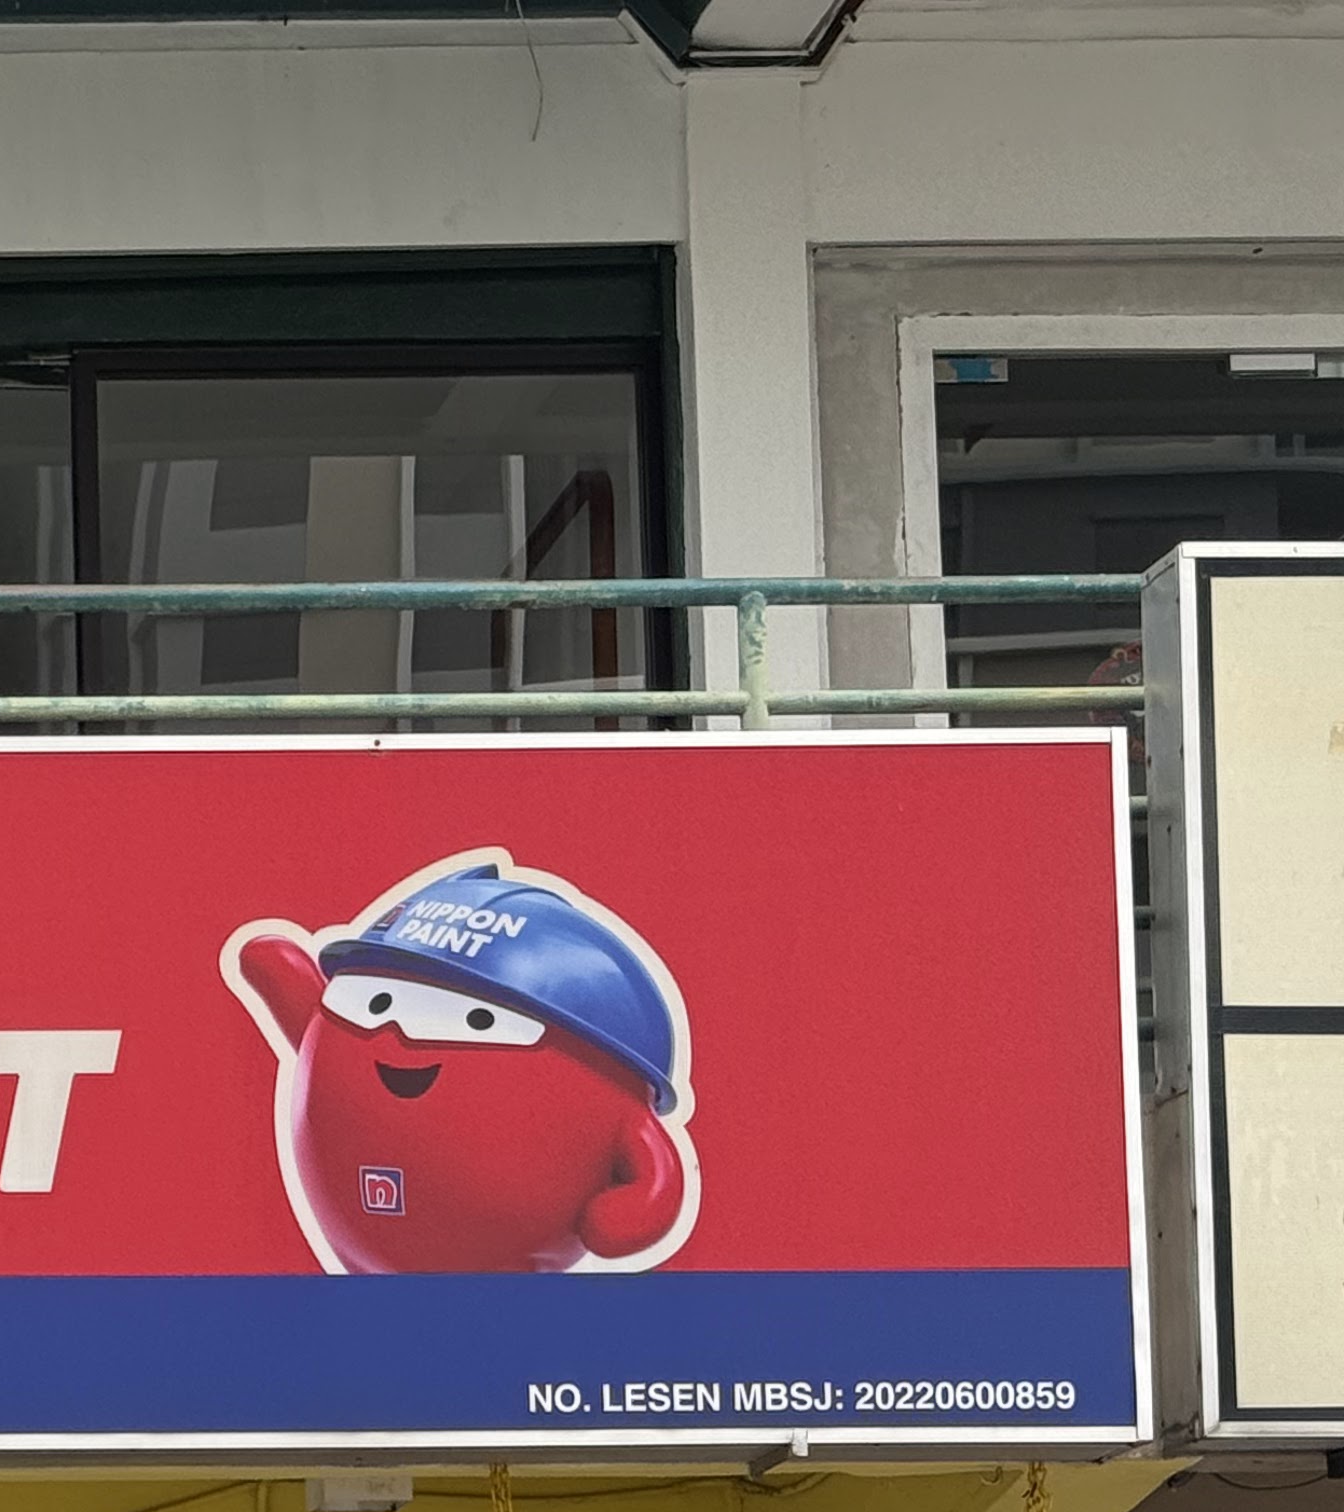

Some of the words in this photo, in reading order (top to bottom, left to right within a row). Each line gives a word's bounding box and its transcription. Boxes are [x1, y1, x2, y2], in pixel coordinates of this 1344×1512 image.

[395, 918, 494, 959] PAINT
[406, 898, 529, 939] NIPPON
[527, 1382, 592, 1413] NO.
[602, 1382, 722, 1412] LESEN
[733, 1382, 845, 1412] MBSJ:
[853, 1381, 1077, 1412] 20220600859
